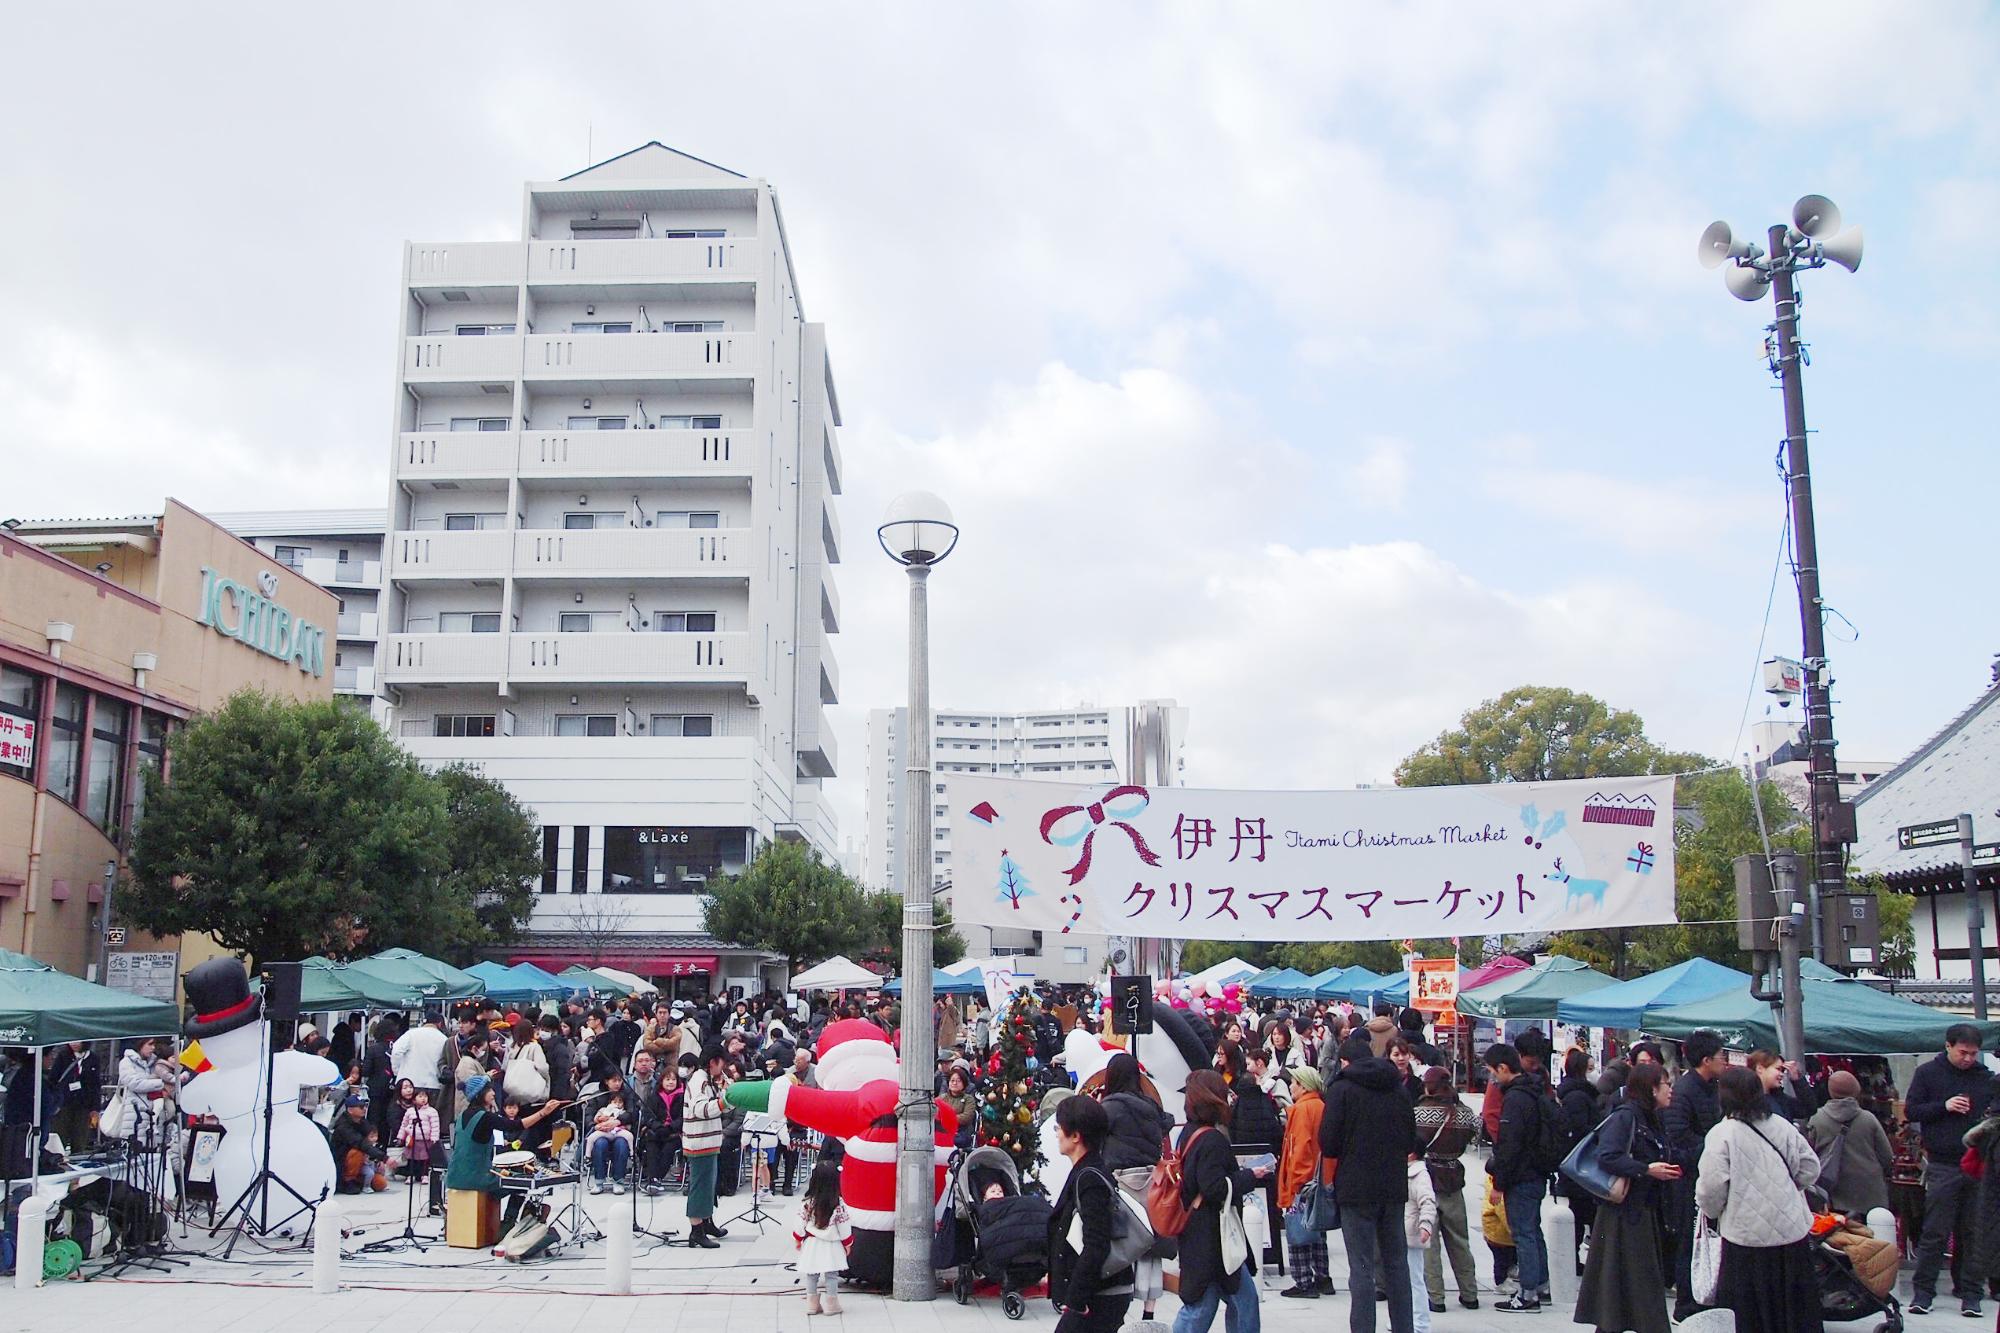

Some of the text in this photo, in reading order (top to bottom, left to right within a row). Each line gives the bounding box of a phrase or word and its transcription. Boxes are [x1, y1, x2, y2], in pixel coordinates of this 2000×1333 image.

[197, 566, 325, 678] ICHIBAN
[1170, 813, 1274, 862] 伊丹
[1285, 824, 1508, 848] Itami Christmas Market
[1123, 873, 1536, 921] クリスマスマーケット
